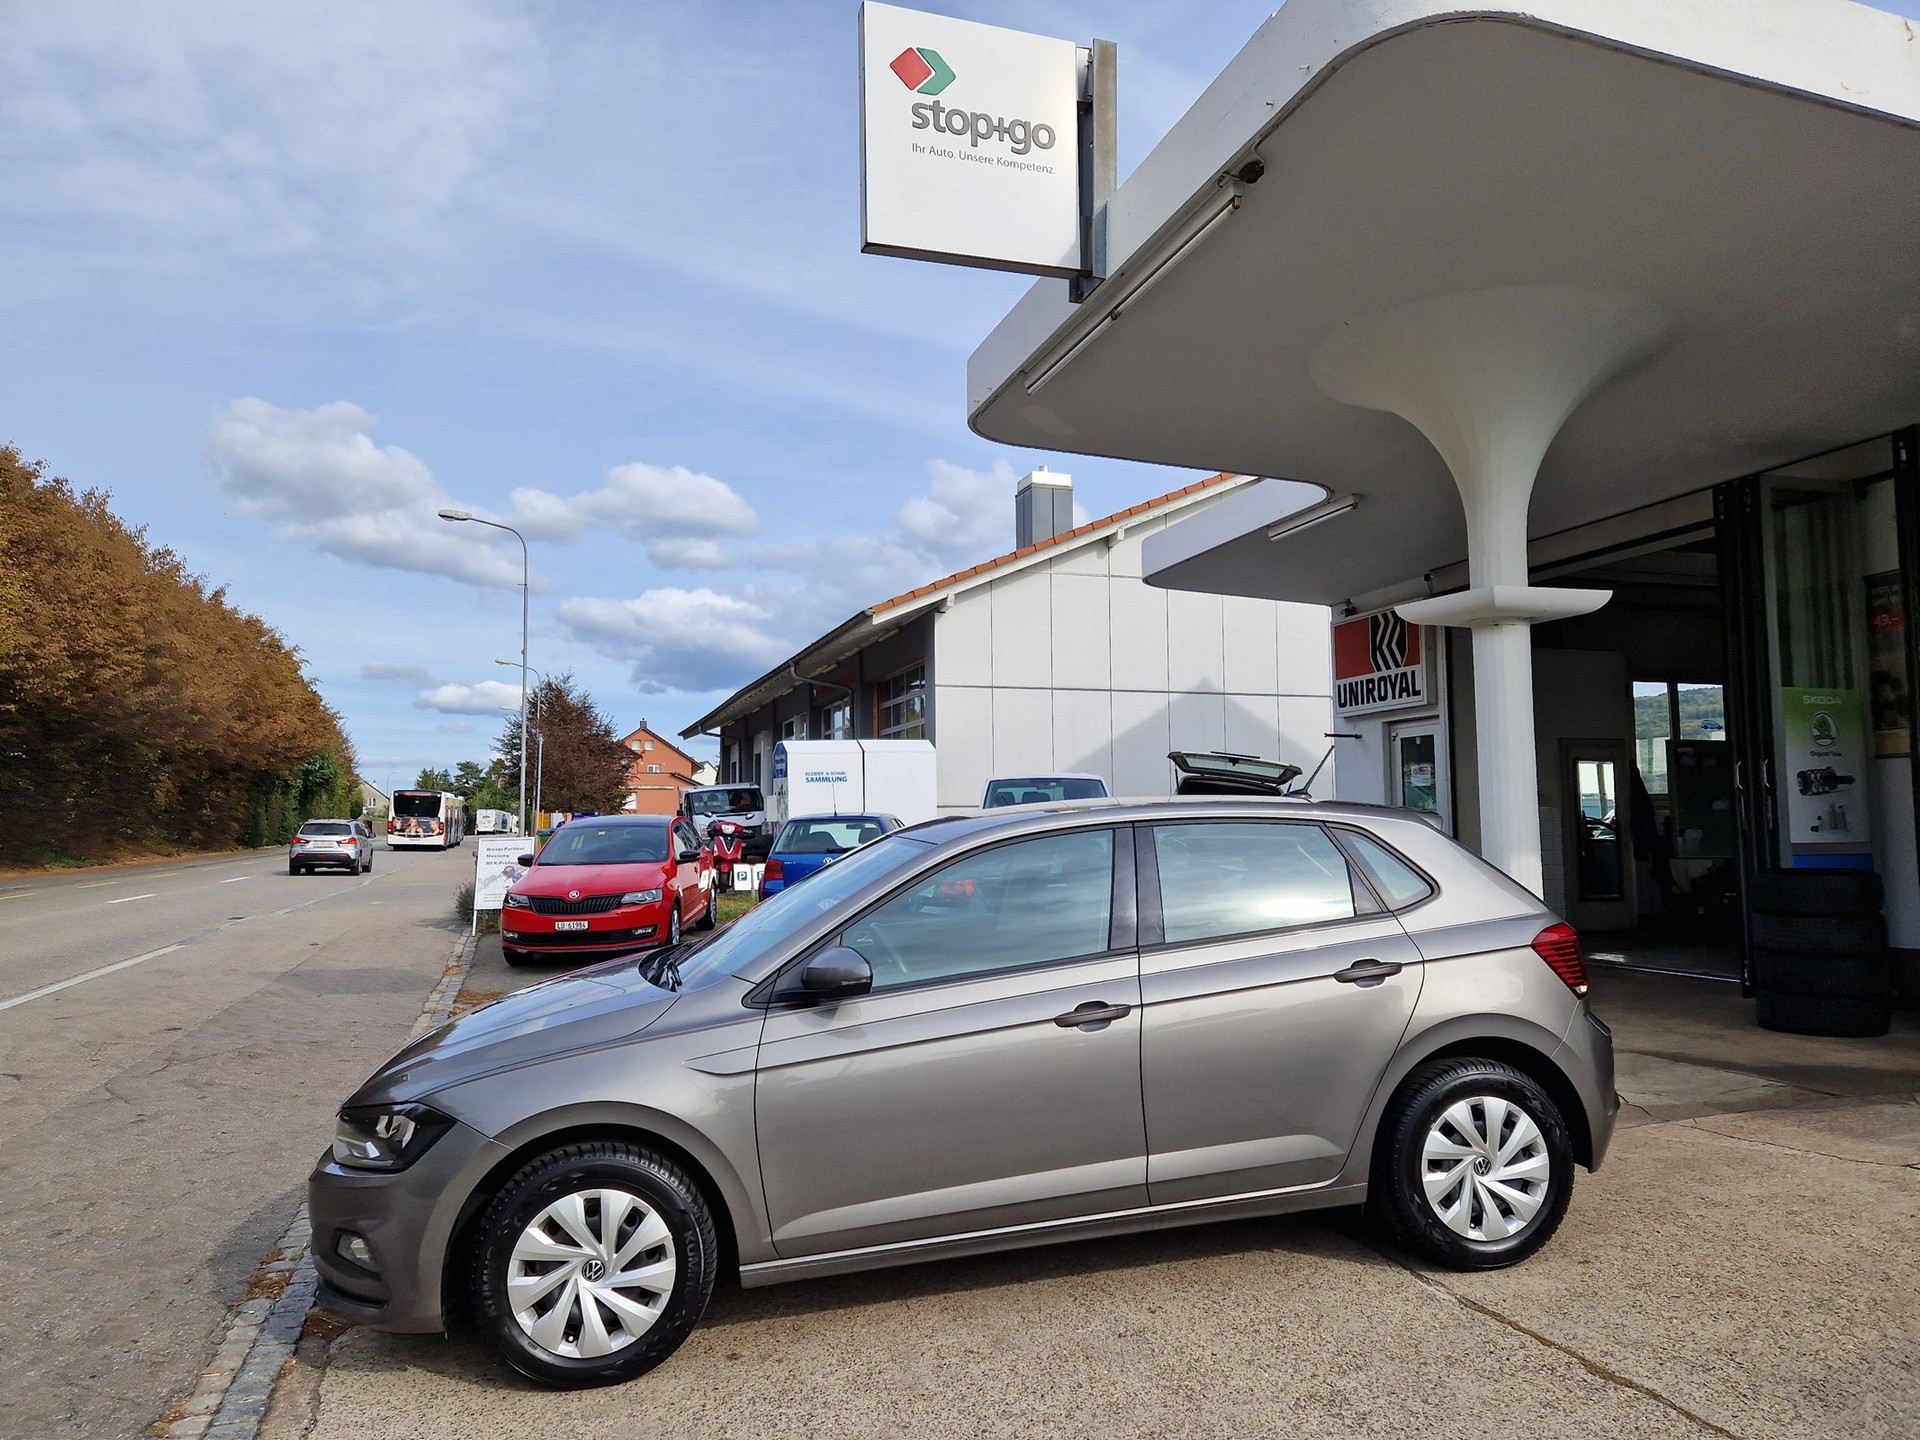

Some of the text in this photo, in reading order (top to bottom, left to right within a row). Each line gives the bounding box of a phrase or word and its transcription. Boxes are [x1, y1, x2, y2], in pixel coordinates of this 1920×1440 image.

[911, 100, 1056, 155] stop+go
[912, 143, 1056, 174] Ihr Auto. Unsere Kompetenz.
[1337, 670, 1421, 708] UNIROYAL
